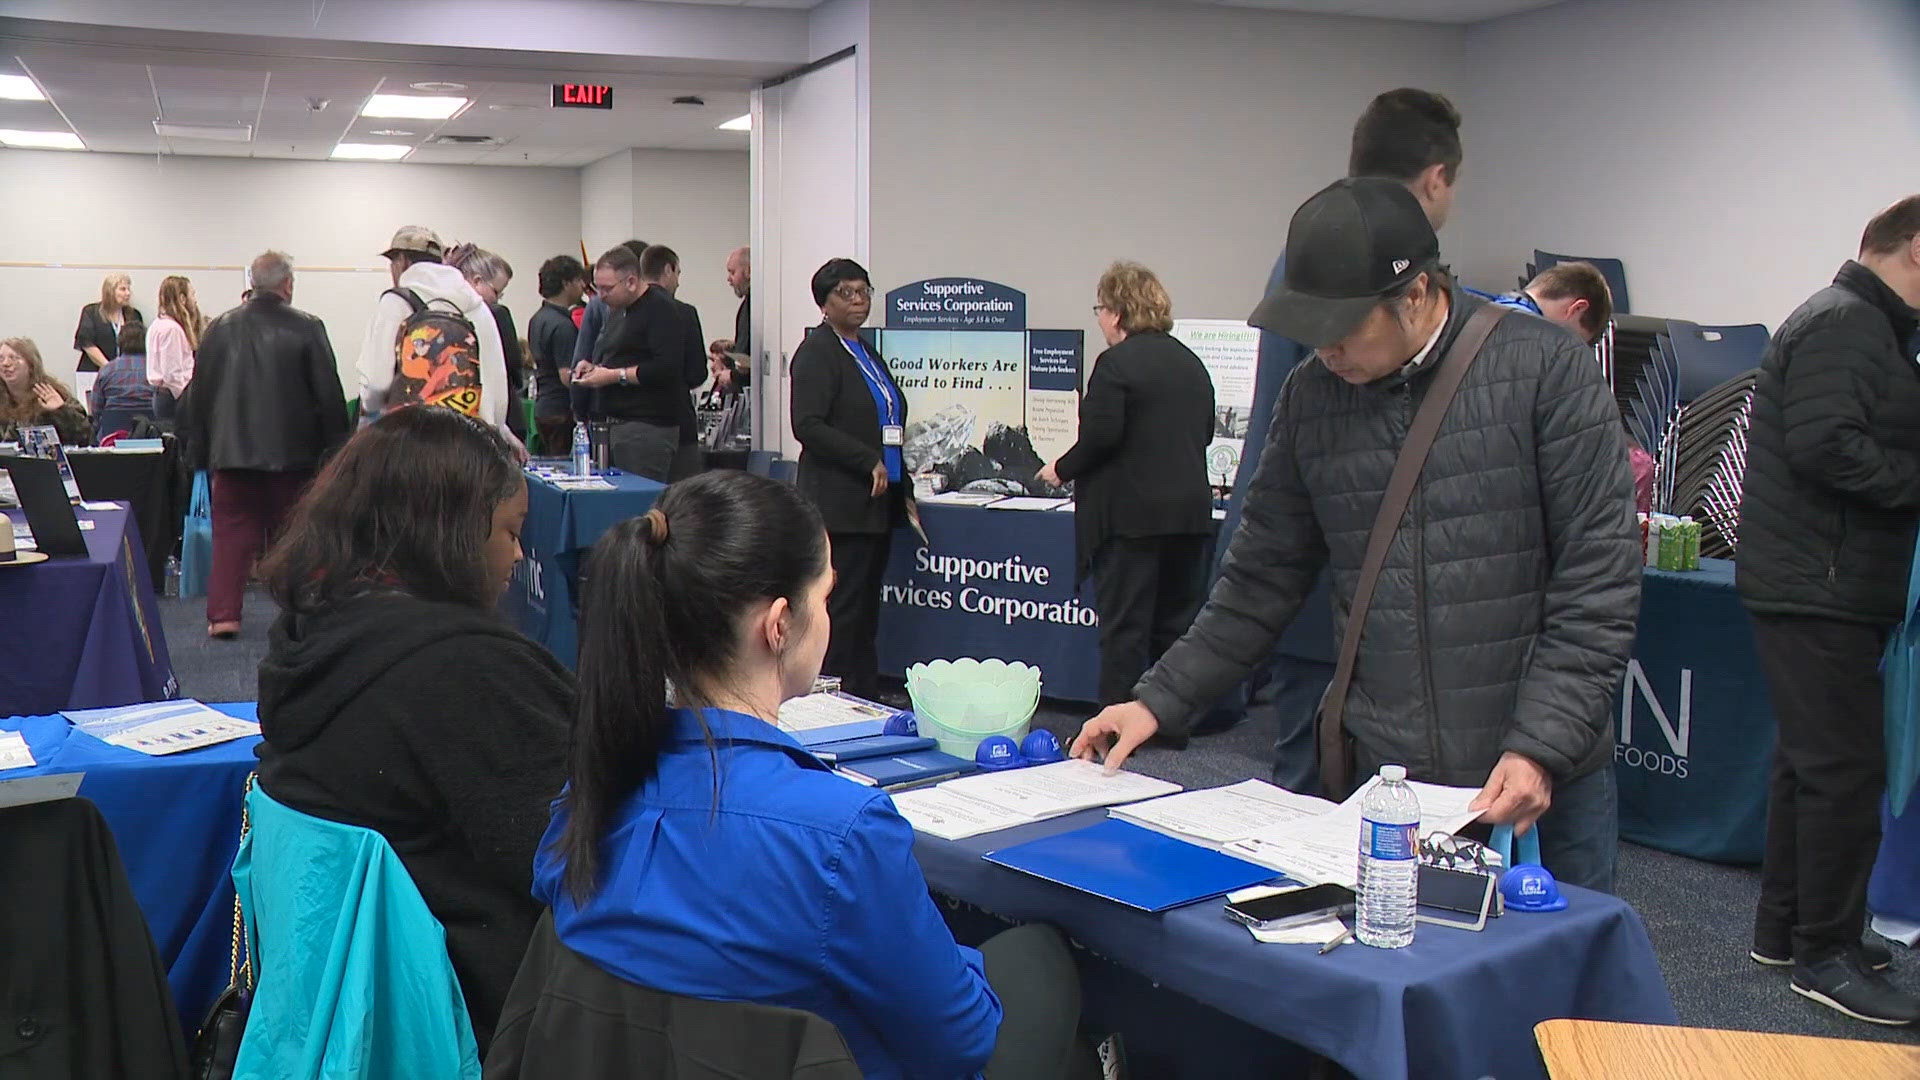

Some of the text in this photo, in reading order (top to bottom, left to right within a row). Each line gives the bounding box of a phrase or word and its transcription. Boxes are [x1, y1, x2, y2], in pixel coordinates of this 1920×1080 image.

[923, 281, 984, 298] Supportive
[897, 298, 1013, 315] Services Corporation
[903, 316, 936, 325] Employment
[938, 316, 959, 324] Services
[992, 316, 1006, 324] Over
[1190, 330, 1203, 339] We
[1044, 348, 1074, 356] Employment
[889, 357, 1018, 373] Good Workers Are
[894, 375, 929, 389] Hard
[934, 376, 947, 389] to
[952, 376, 984, 390] Find
[915, 547, 1049, 585] Supportive
[880, 579, 1099, 627] rvices Corporatio
[1614, 744, 1689, 779] FOODS
